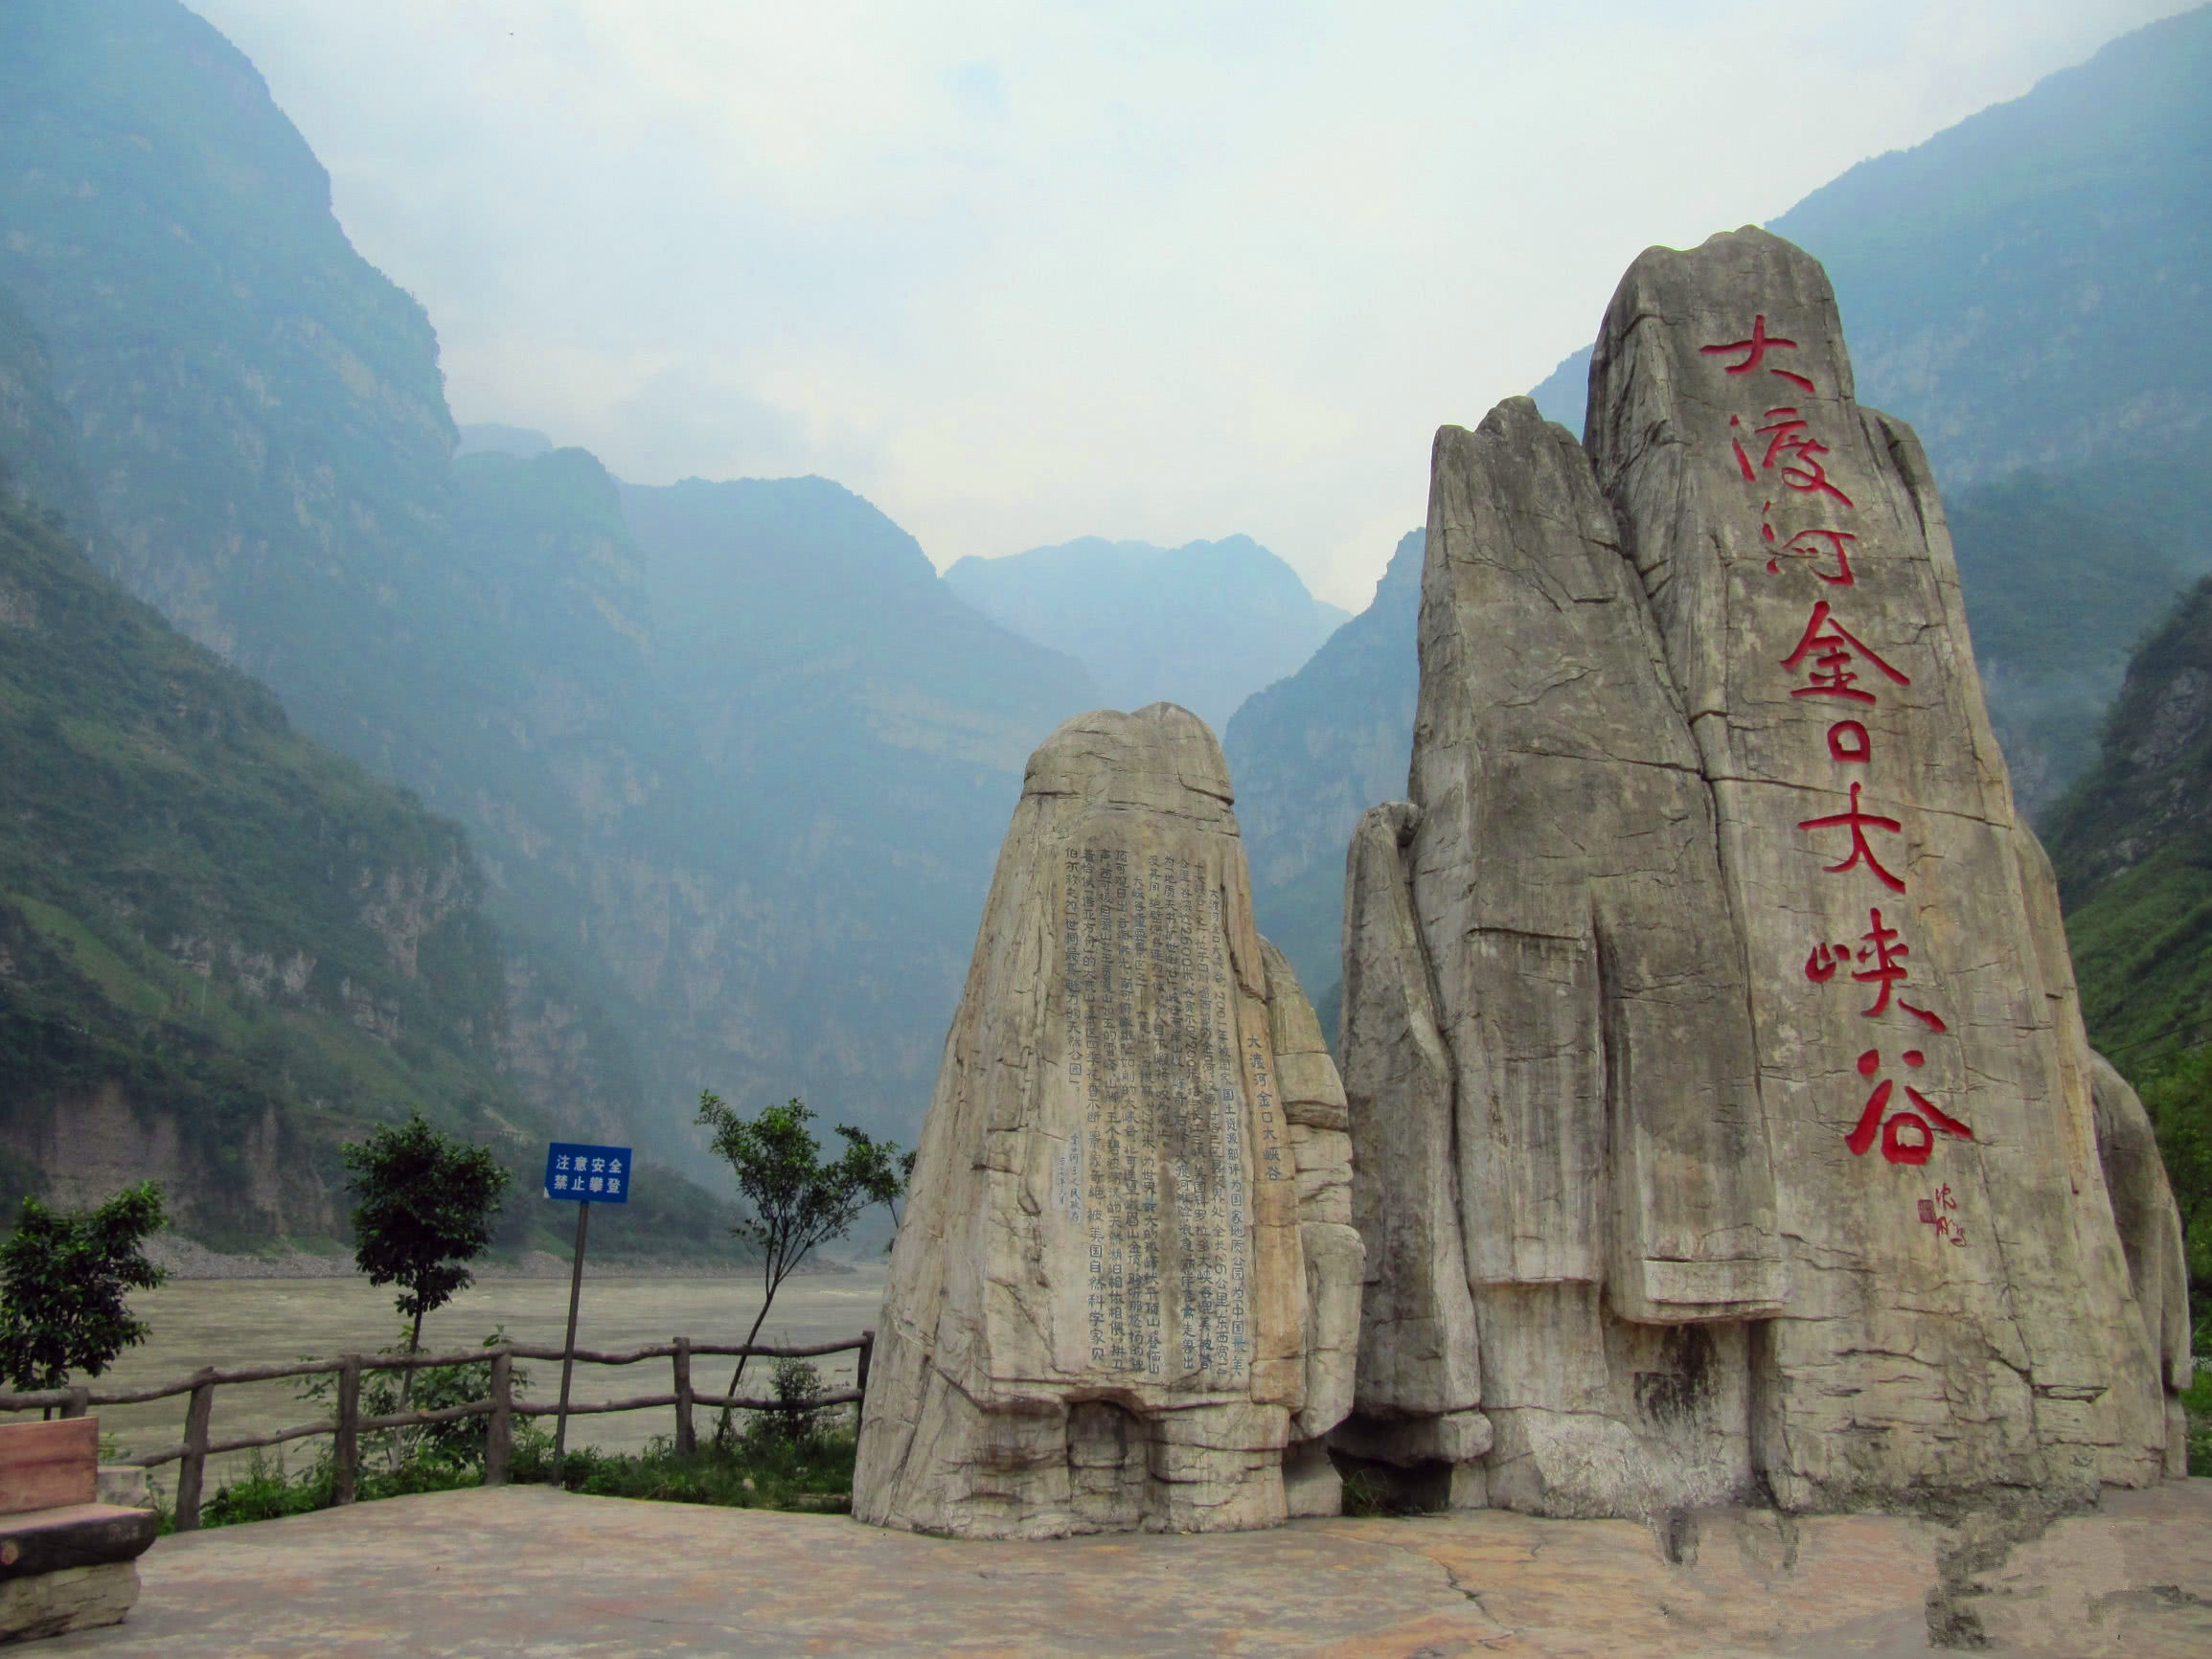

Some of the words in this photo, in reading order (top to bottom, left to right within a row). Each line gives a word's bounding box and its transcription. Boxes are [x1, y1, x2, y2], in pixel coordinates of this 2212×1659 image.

[1701, 316, 1973, 1165] 大渡河金口大峡谷
[1248, 1034, 1282, 1181] 大渡河金口大峡谷
[554, 1174, 621, 1194] 禁止攀登
[556, 1154, 623, 1173] 注意安全
